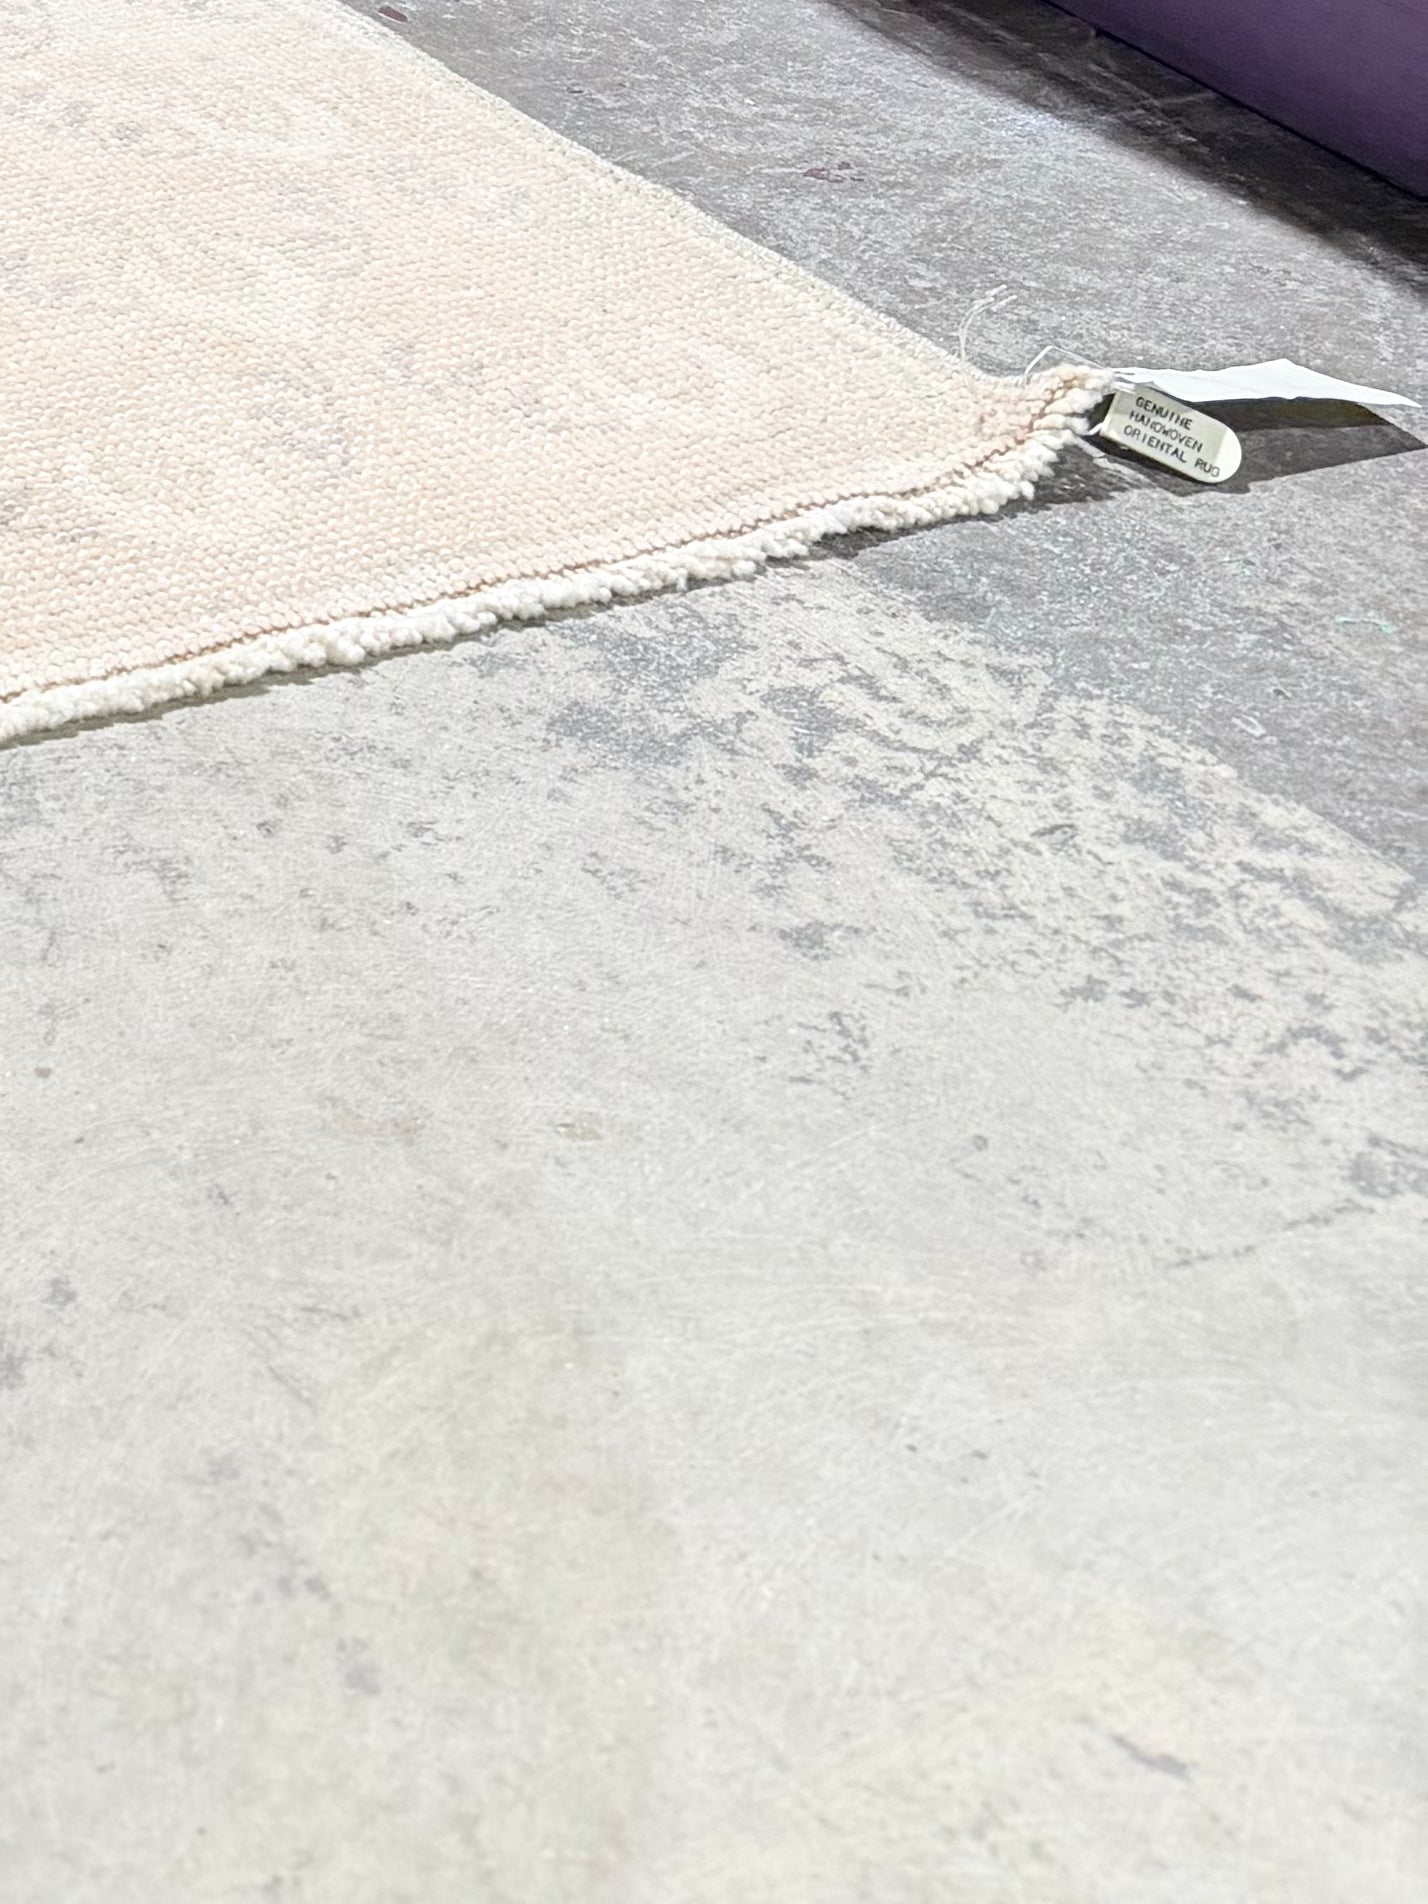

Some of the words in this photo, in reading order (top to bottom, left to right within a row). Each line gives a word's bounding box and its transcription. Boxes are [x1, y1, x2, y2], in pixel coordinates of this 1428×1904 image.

[1129, 410, 1203, 452] HANDWOVEN
[1136, 396, 1193, 430] GENUINE
[1124, 425, 1187, 463] ORIENTAL
[1194, 458, 1221, 477] RUG
